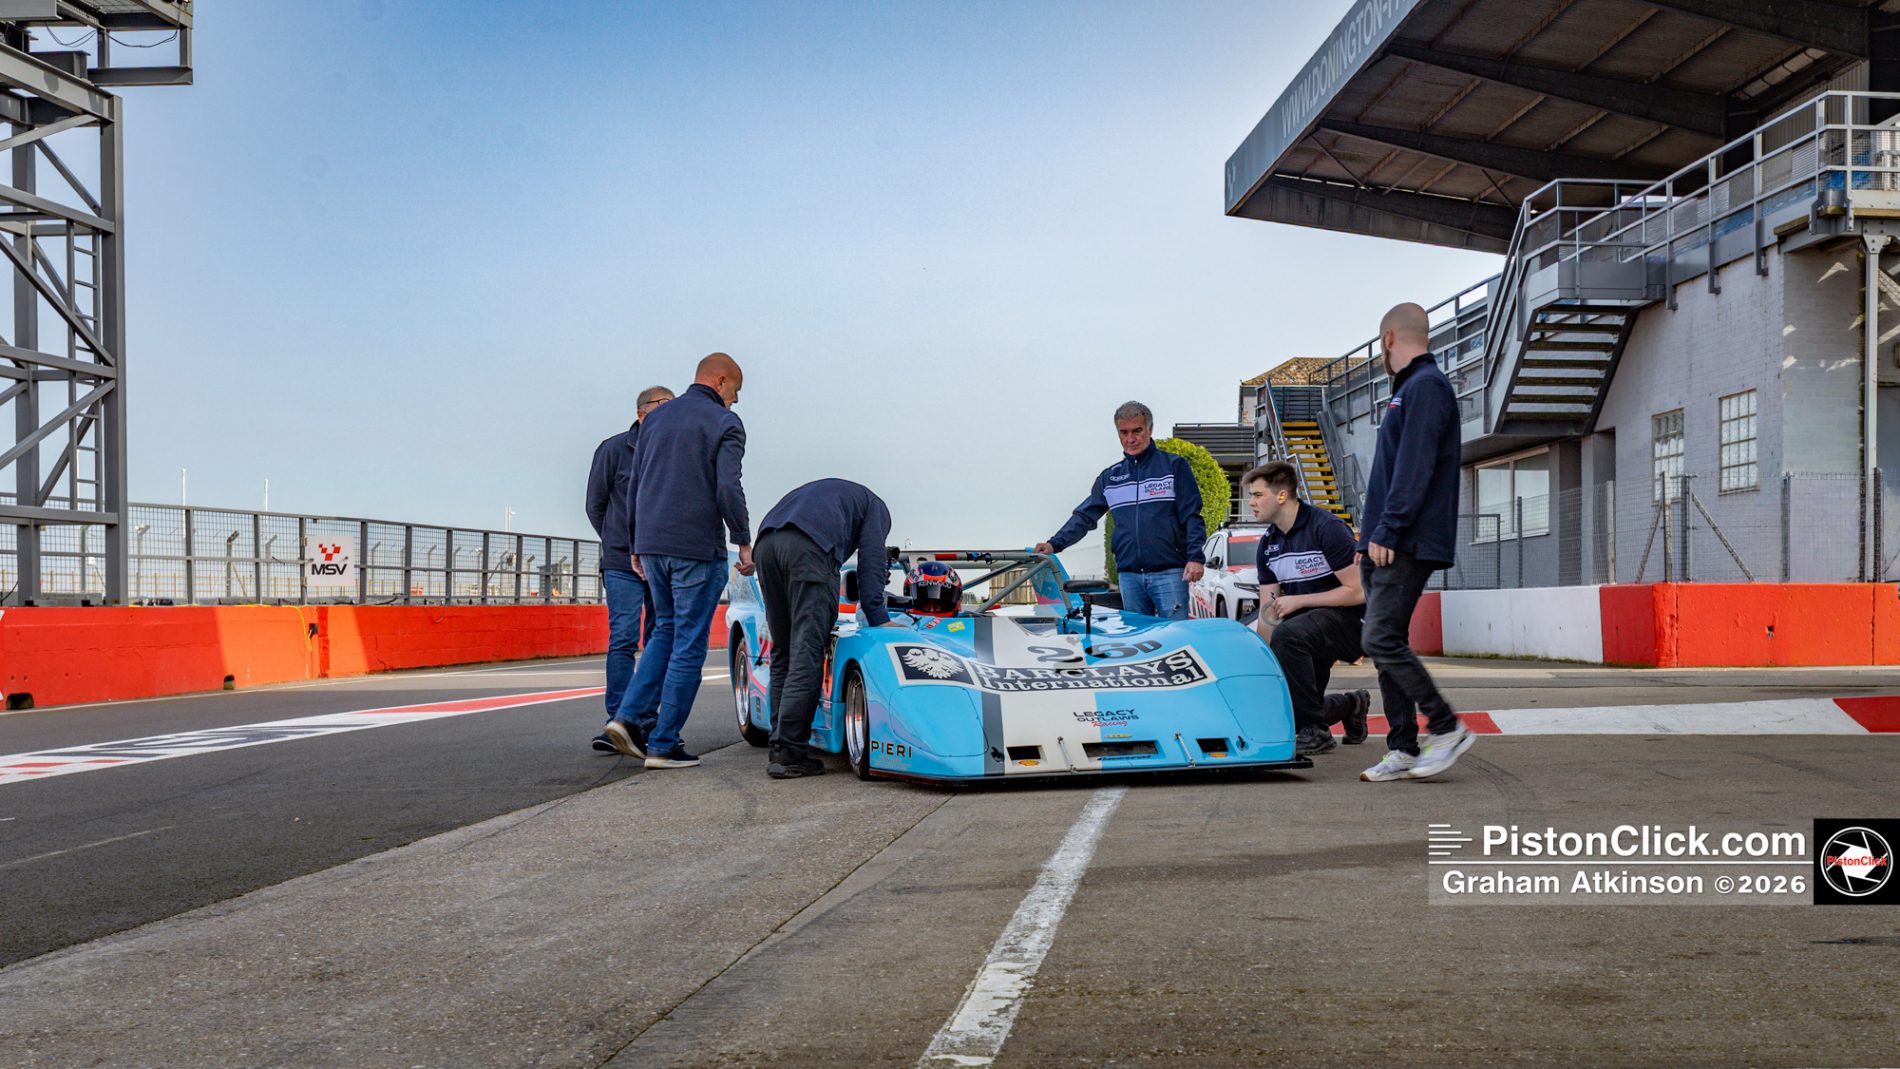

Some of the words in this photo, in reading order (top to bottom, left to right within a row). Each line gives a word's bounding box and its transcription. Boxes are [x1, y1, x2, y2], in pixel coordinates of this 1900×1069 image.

[1281, 0, 1402, 138] WWW.DONINGTON-
[311, 563, 347, 575] MSV
[1295, 556, 1322, 564] LEGACY
[976, 652, 1194, 681] BARCLAYS
[982, 666, 1203, 690] International
[1073, 709, 1135, 717] LEGACY
[871, 740, 912, 758] PIERI
